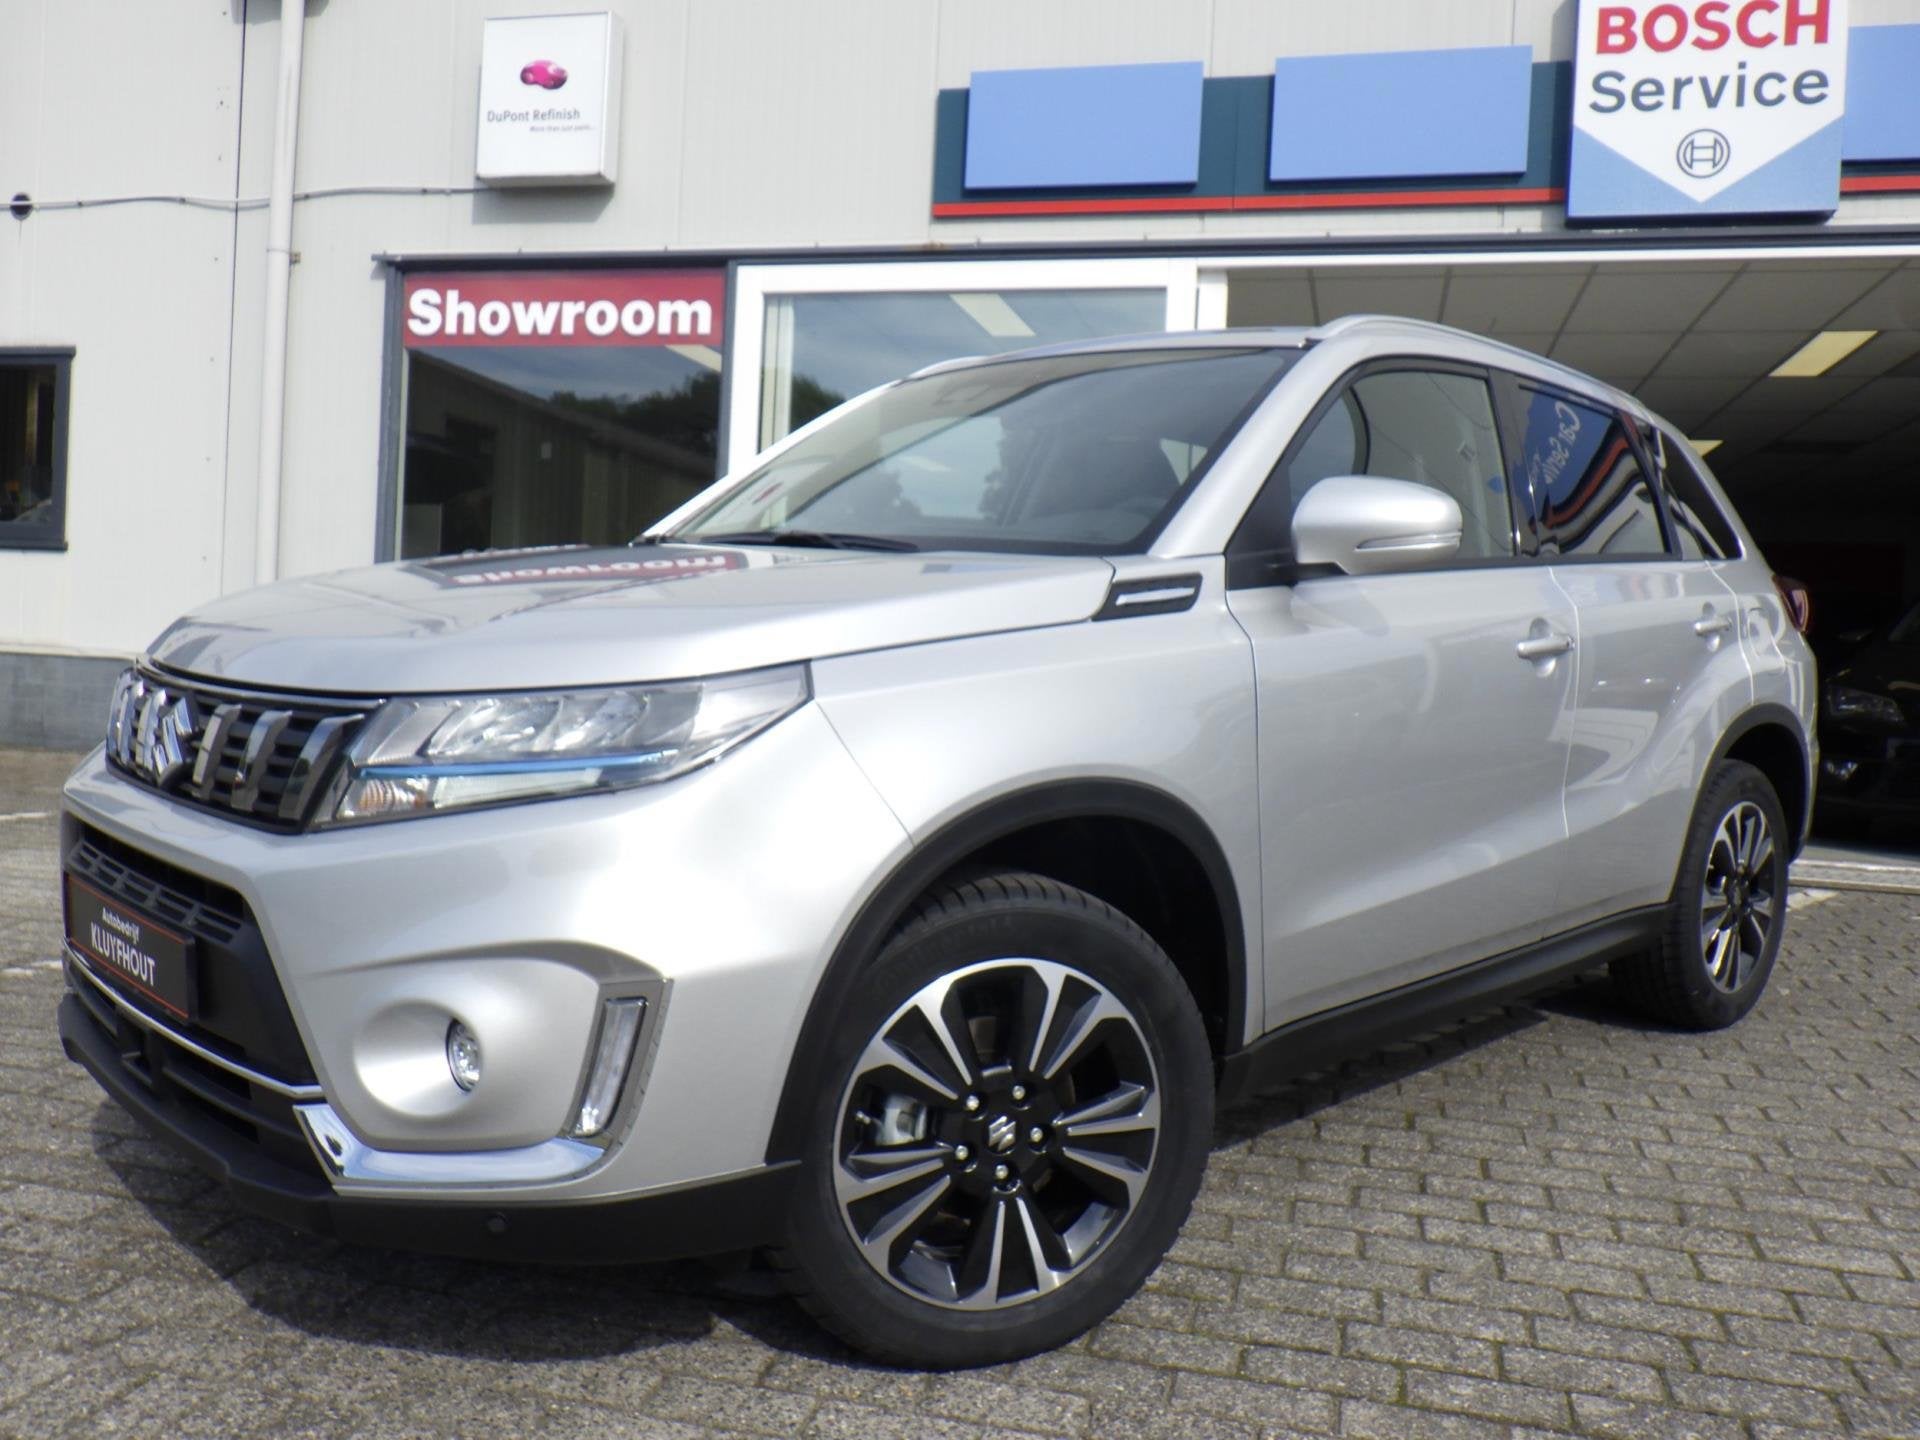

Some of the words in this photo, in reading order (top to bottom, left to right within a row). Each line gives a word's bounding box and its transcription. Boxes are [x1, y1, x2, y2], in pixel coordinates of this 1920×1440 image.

[1596, 0, 1831, 54] BOSCH
[1589, 61, 1829, 113] Service
[487, 110, 529, 122] DuPont
[533, 108, 580, 120] Refinish
[408, 288, 712, 336] Showroom
[91, 922, 156, 987] KLUYFHOUT
